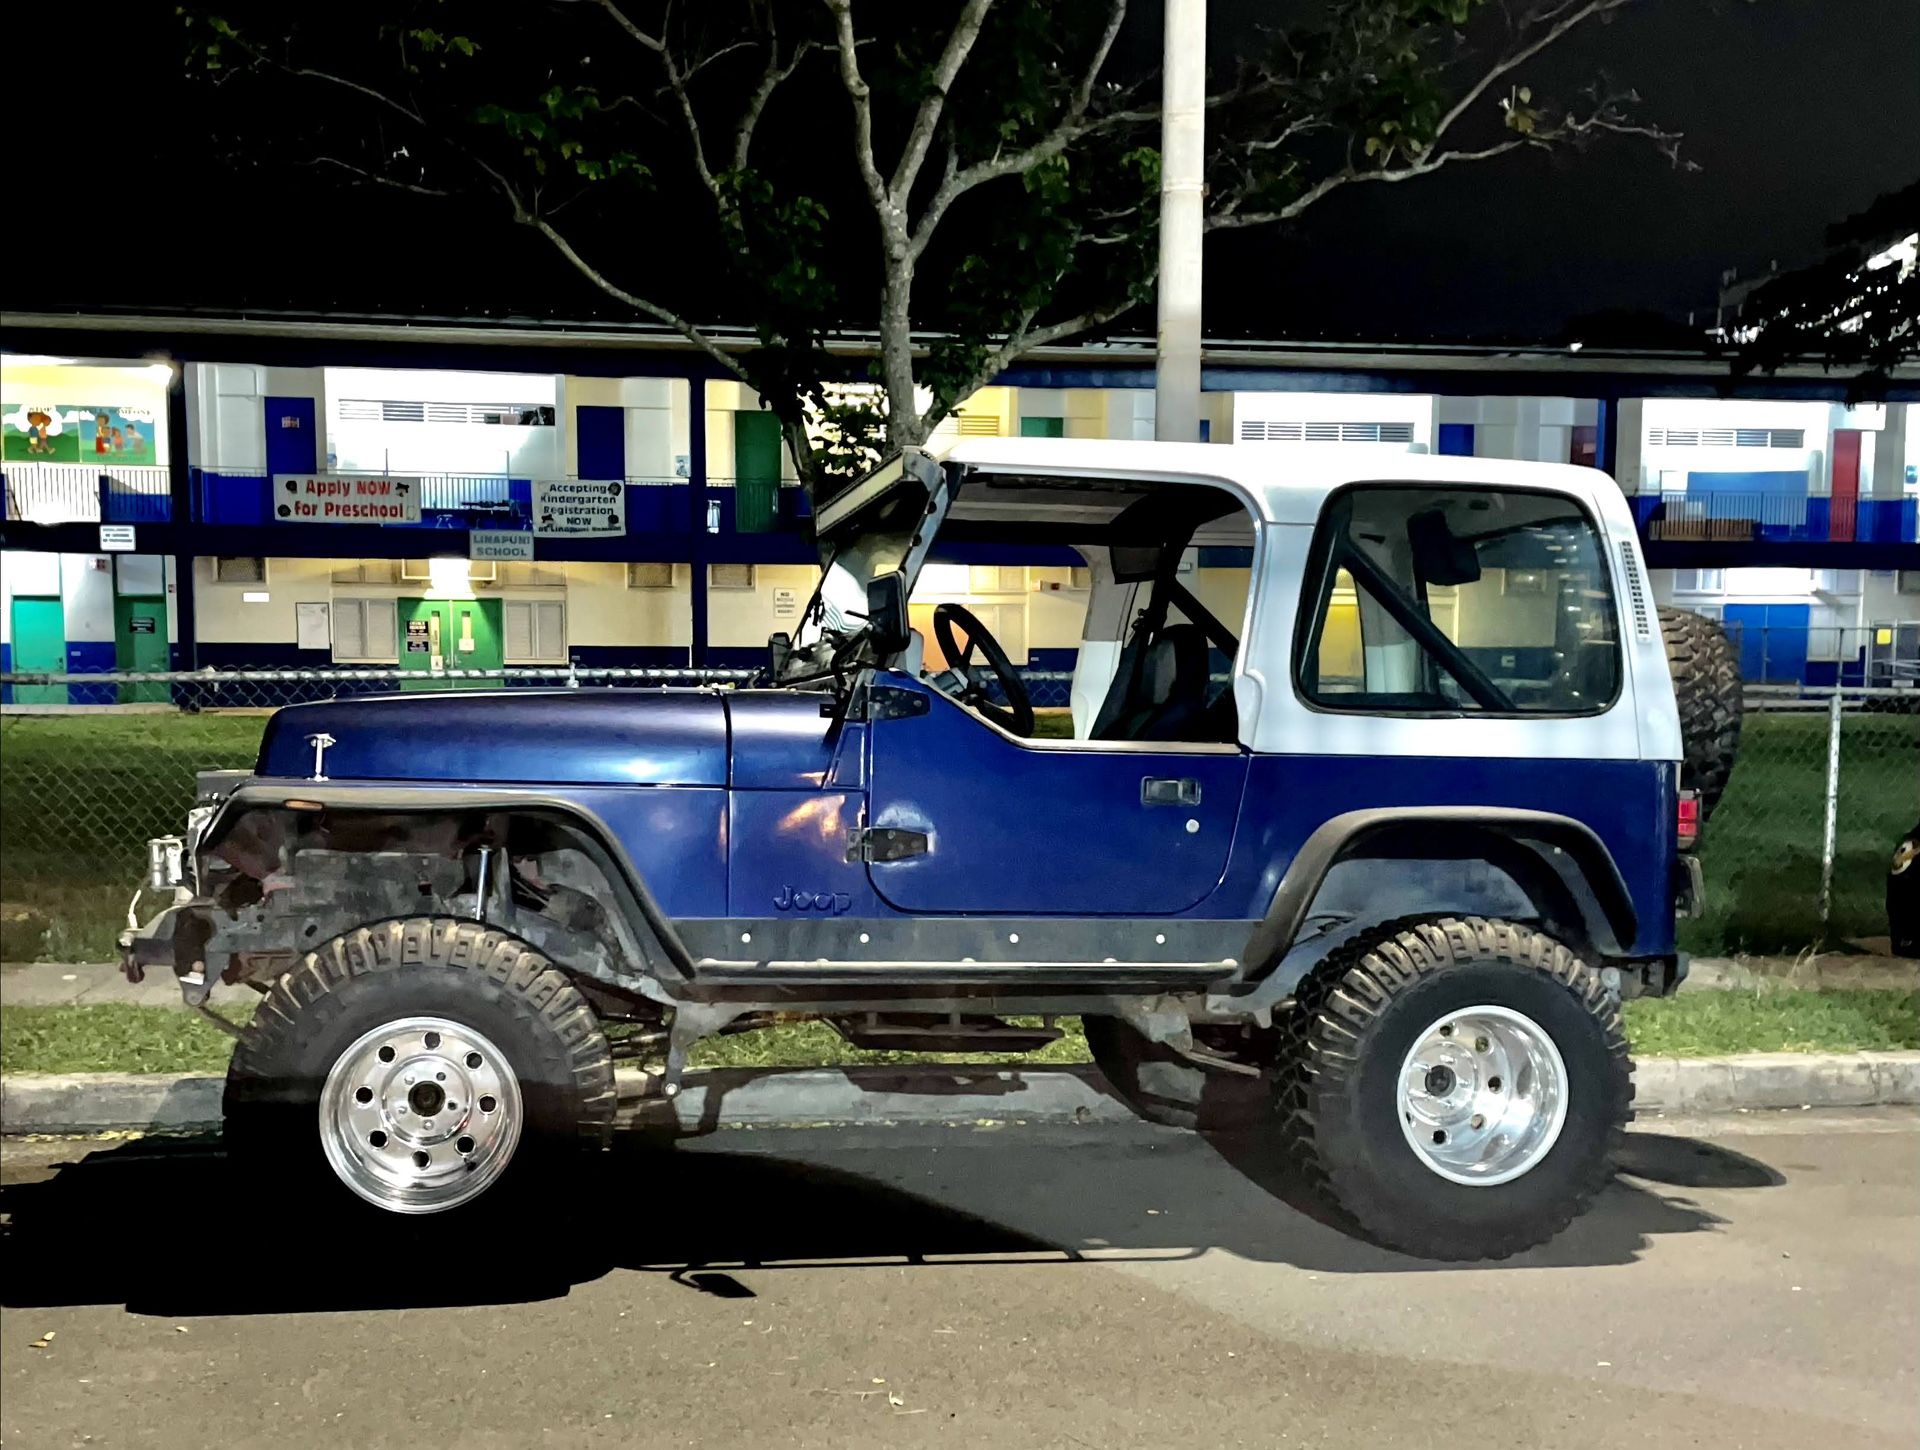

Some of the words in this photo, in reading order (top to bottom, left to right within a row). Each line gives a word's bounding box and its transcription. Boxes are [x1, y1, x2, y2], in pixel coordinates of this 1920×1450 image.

[305, 480, 351, 496] Apply
[356, 480, 391, 495] NOW
[549, 483, 607, 494] Accepting
[540, 495, 616, 504] Kindergarten
[294, 500, 318, 516] for
[324, 502, 403, 518] Preschool
[543, 506, 614, 515] Registration
[566, 517, 592, 525] NOW
[473, 535, 530, 545] LINAPUNI
[476, 547, 527, 556] SCHOOL
[773, 884, 852, 915] Jeep
